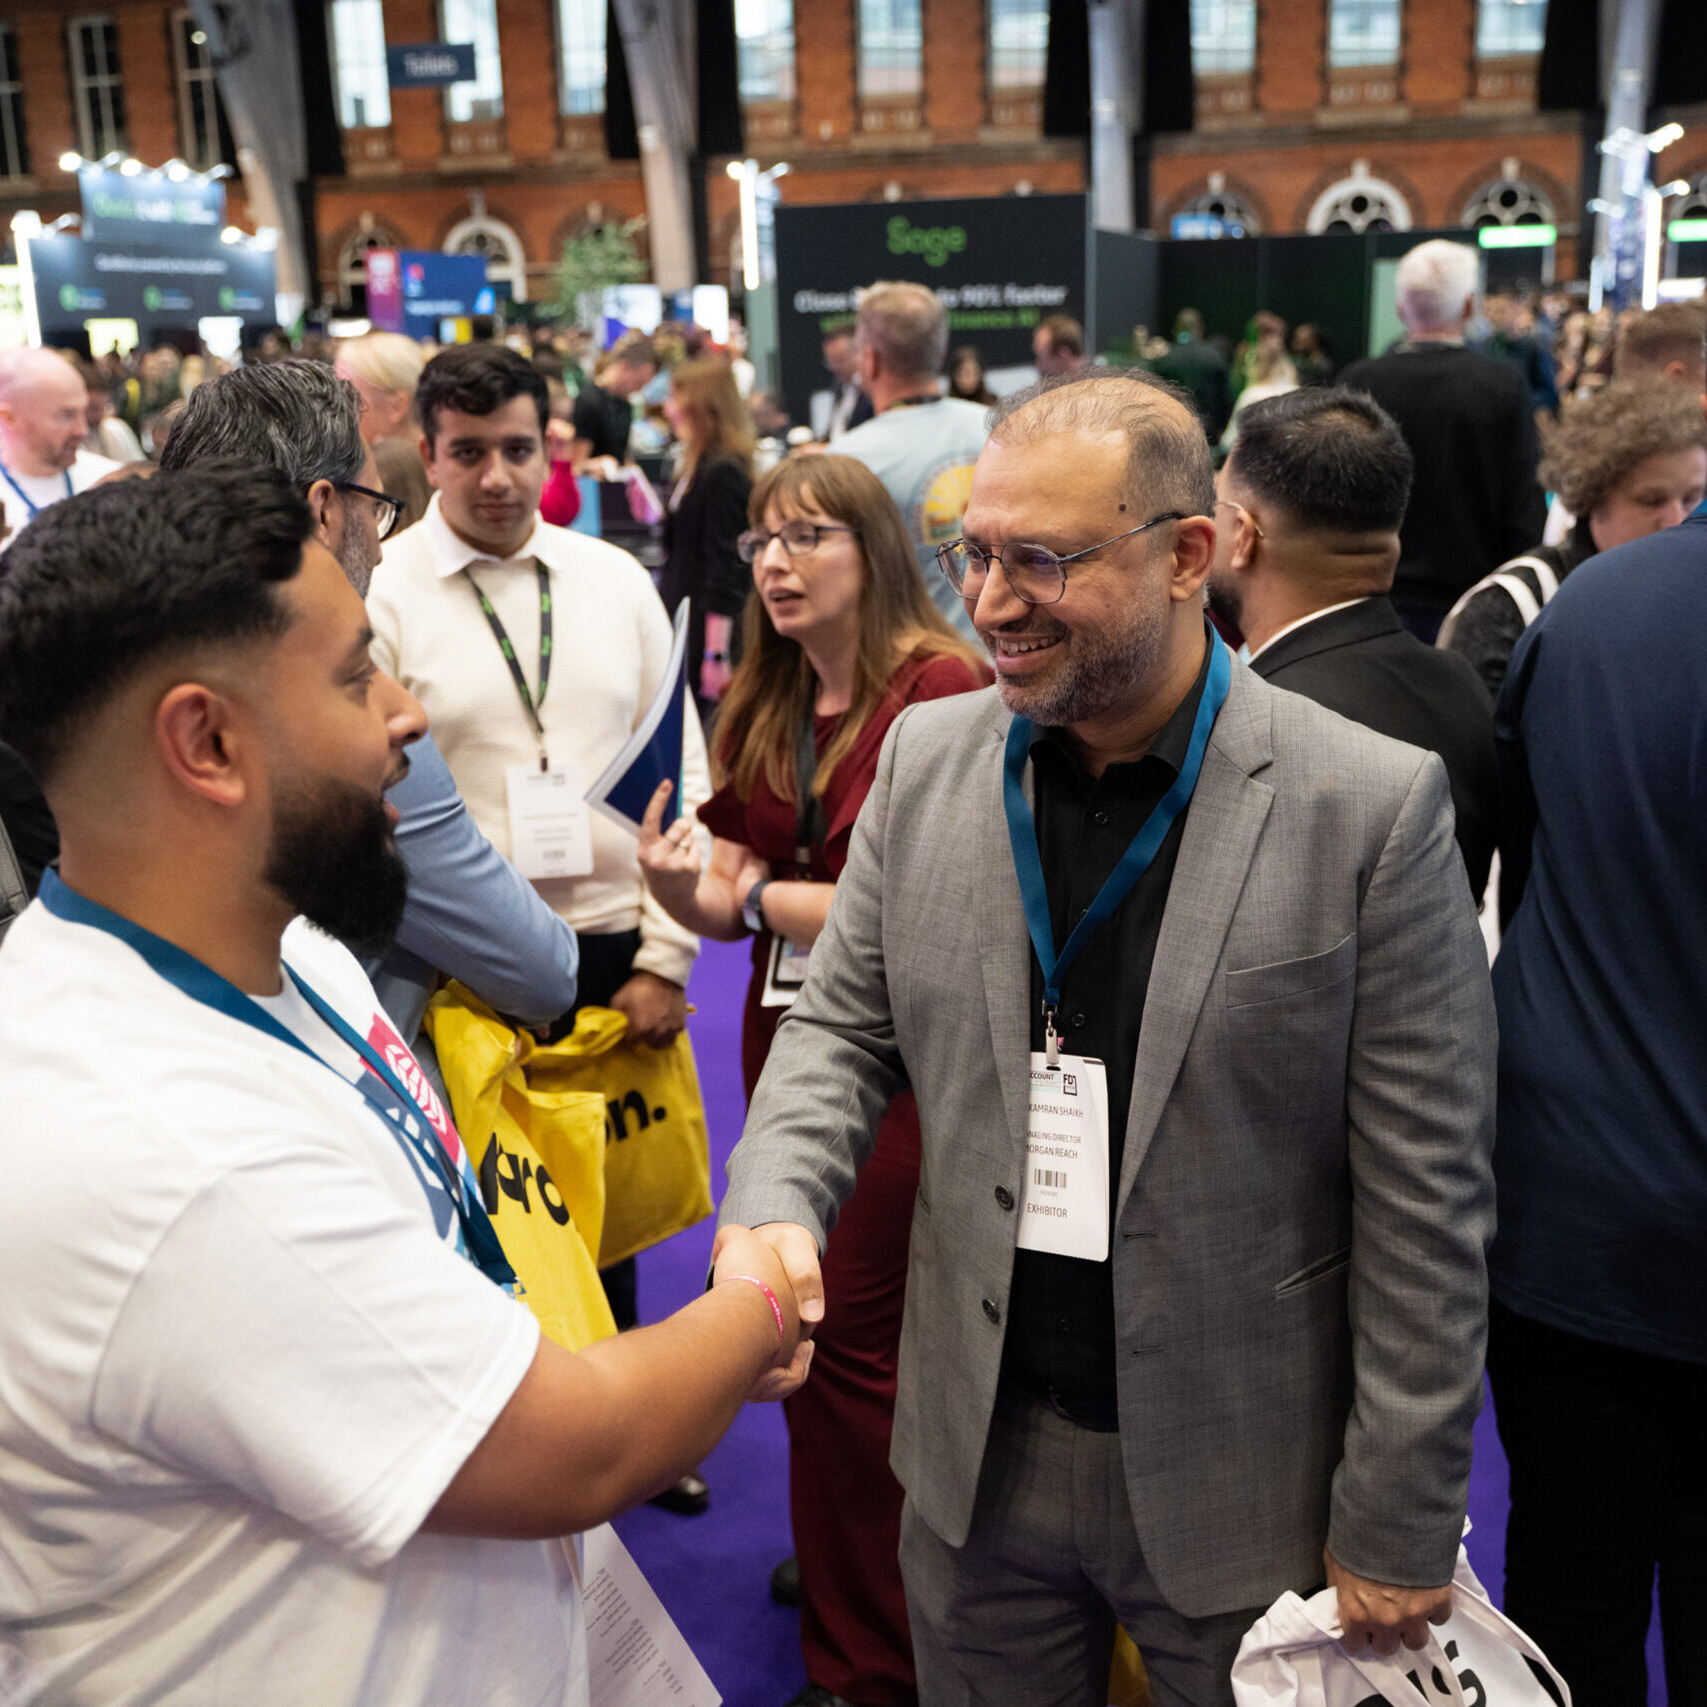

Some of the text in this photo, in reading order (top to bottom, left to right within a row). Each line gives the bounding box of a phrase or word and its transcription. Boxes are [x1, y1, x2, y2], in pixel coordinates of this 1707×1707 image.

[887, 216, 967, 267] Sage
[794, 289, 850, 313] Close
[960, 283, 1001, 308] 90%
[1003, 282, 1068, 307] faster
[949, 310, 1015, 330] inance
[605, 1090, 666, 1143] n.
[1028, 1104, 1058, 1114] KAMRAN
[1052, 1133, 1081, 1144] DIRECTOR
[1055, 1147, 1078, 1159] REACH
[1027, 1203, 1067, 1218] EXHIBITOR
